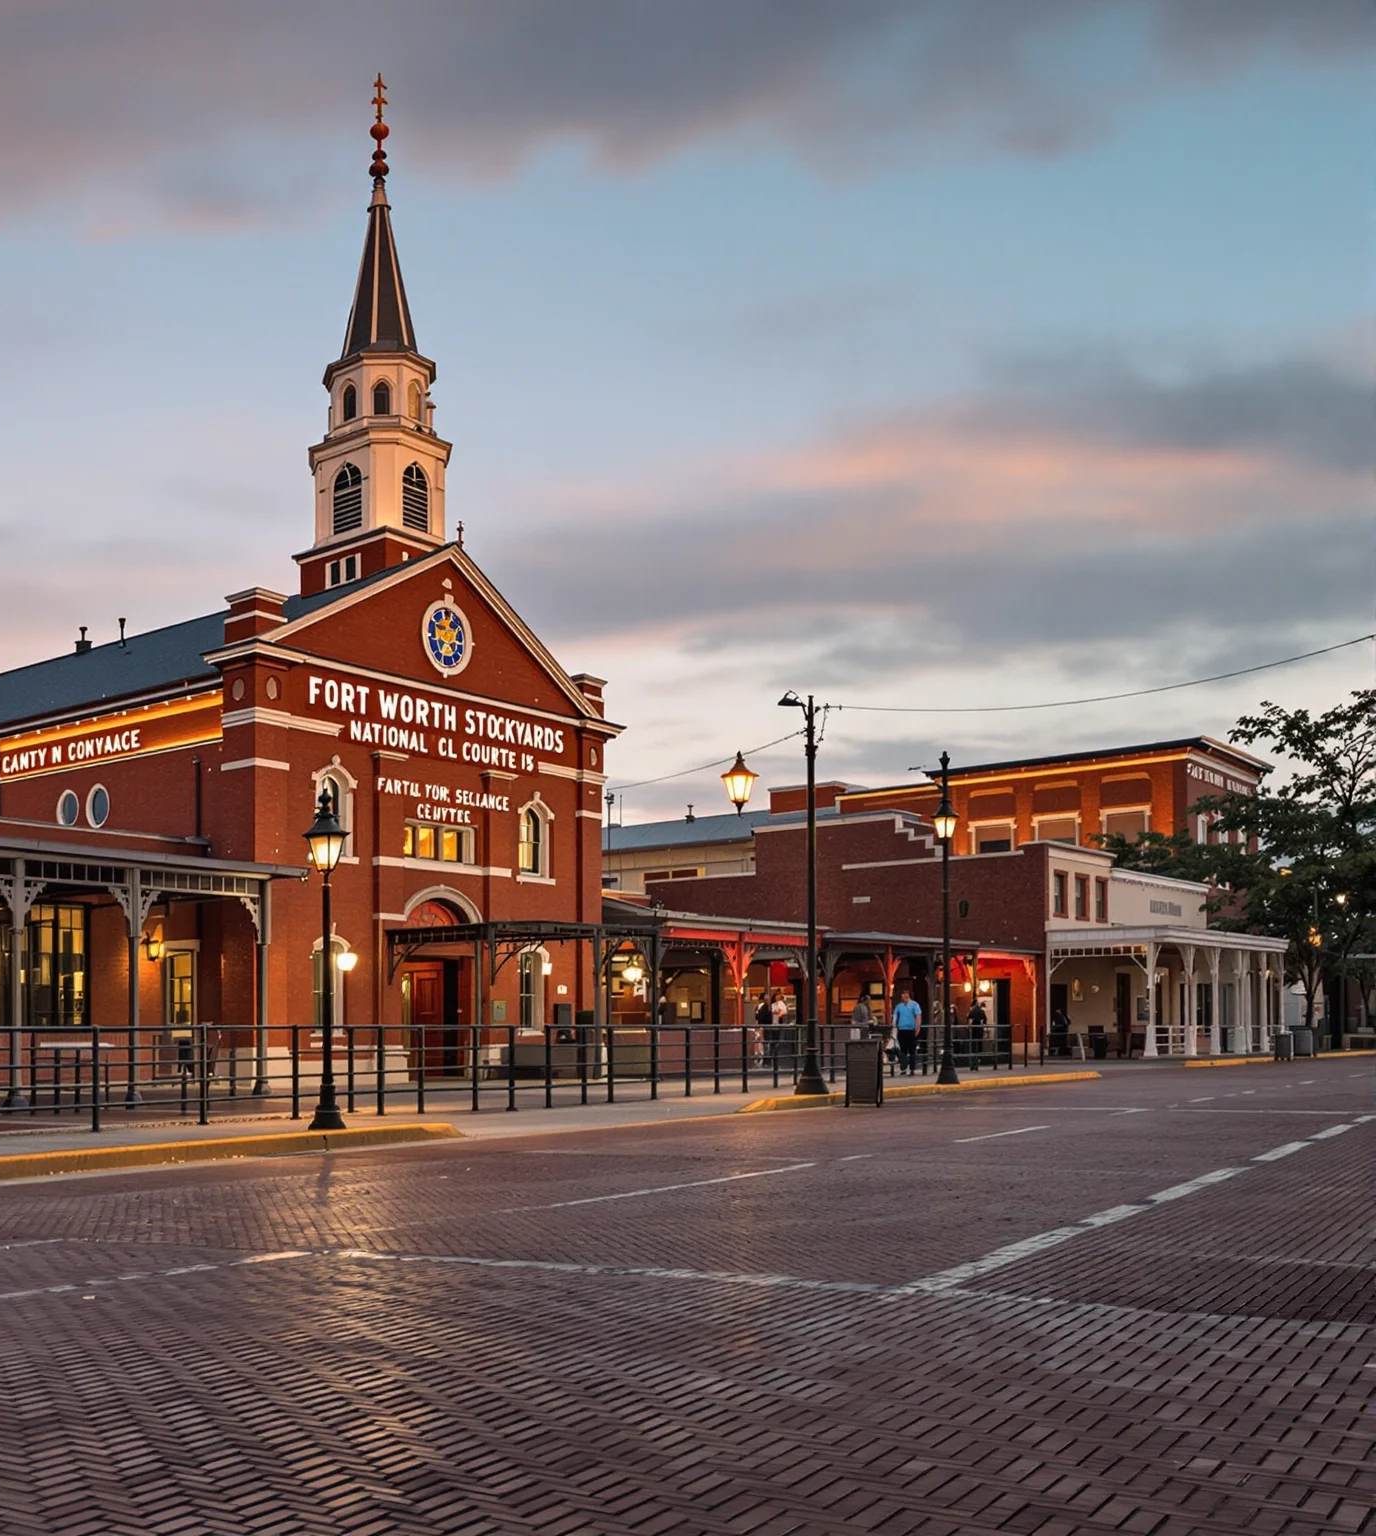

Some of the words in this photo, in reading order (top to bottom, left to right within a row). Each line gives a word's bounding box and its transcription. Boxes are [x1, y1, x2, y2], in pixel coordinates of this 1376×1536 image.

[309, 676, 370, 715] FORT
[378, 689, 457, 732] WORTH
[465, 709, 564, 753] STOCKYARDS
[350, 720, 428, 753] NATIONAL
[438, 737, 457, 759] CL
[462, 742, 517, 769] COURTE
